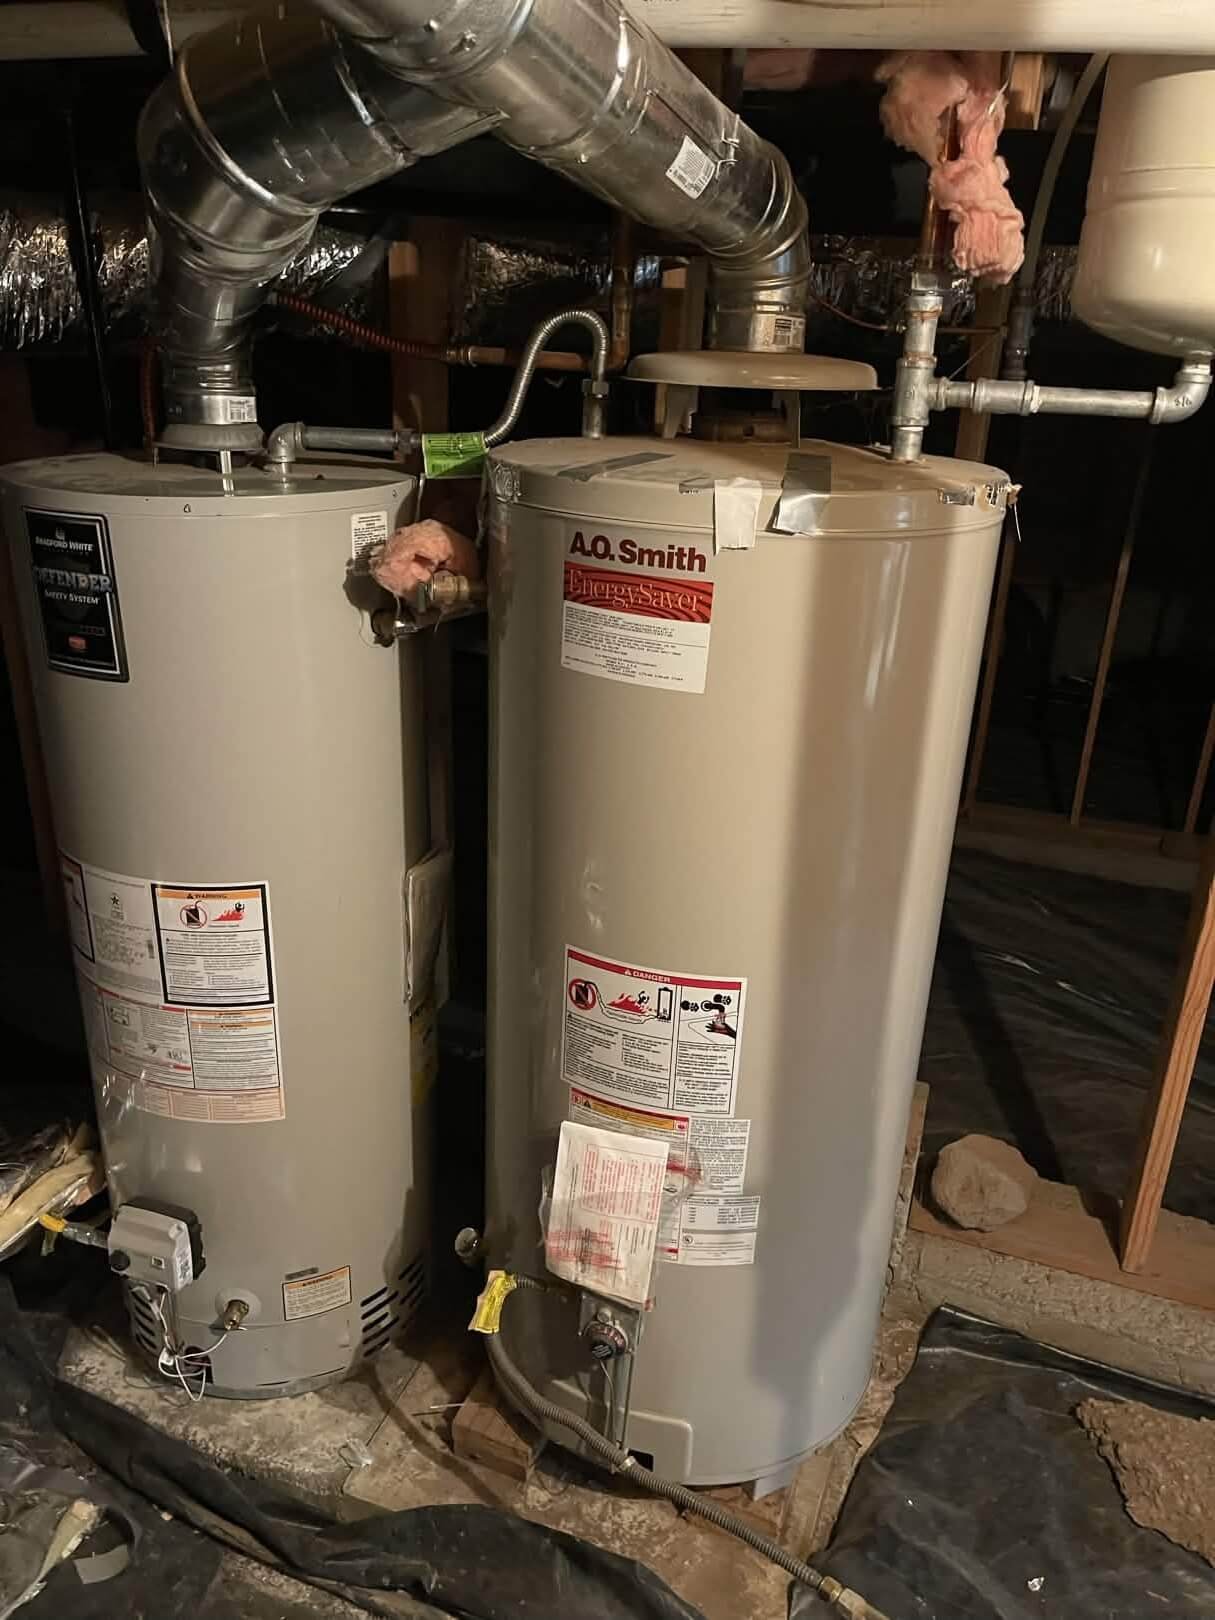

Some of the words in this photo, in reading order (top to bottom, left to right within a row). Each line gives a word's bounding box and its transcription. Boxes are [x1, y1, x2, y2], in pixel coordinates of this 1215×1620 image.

[69, 541, 94, 552] WHITE
[570, 531, 615, 561] A.O.
[619, 539, 707, 573] Smith
[32, 566, 113, 593] DEFENDER
[68, 592, 100, 605] SYSTEM
[632, 971, 671, 983] DANGER
